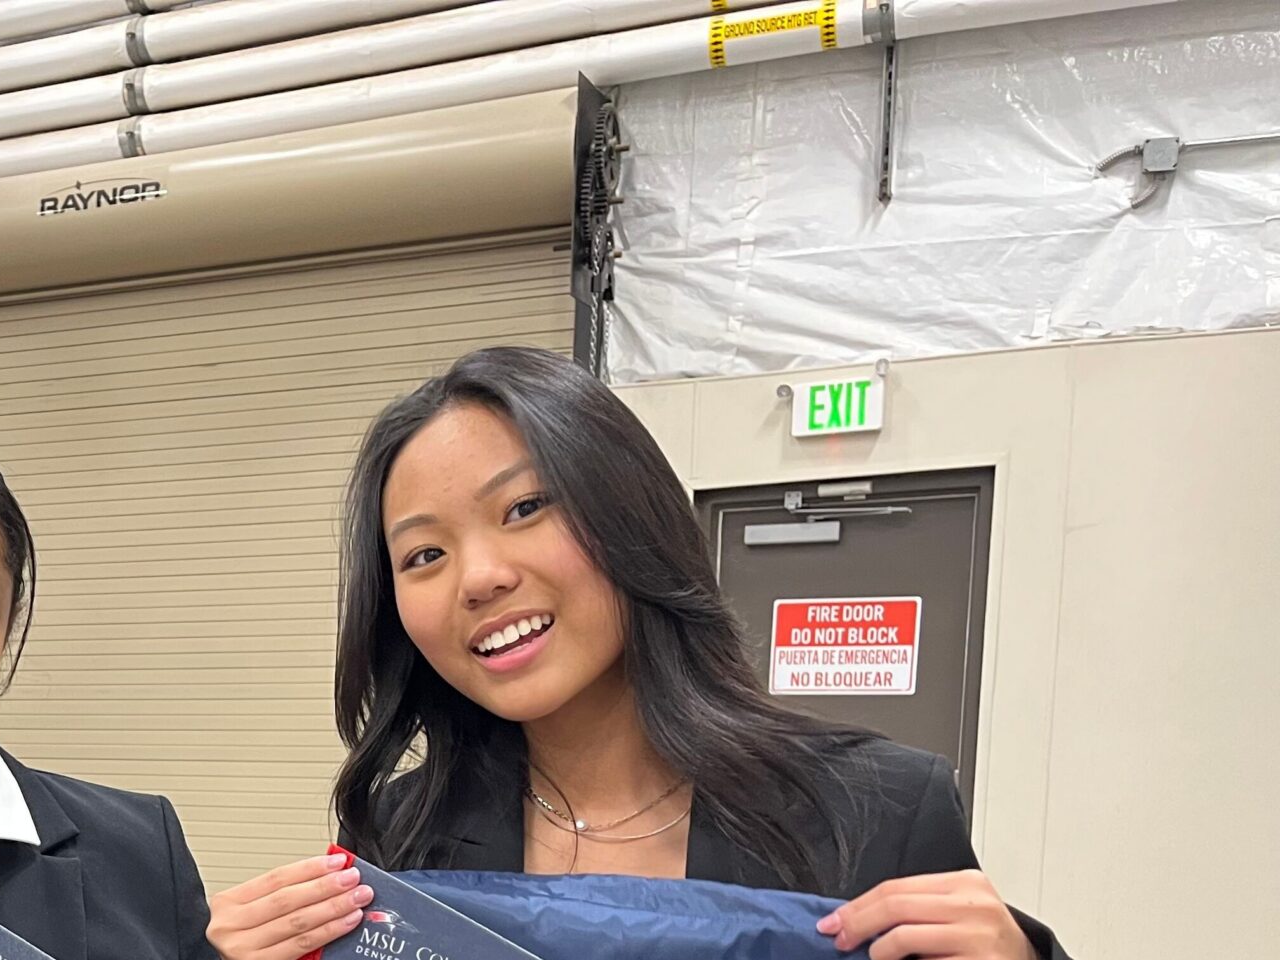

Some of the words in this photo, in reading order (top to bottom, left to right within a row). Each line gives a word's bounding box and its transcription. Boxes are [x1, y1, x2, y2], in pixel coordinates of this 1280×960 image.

[723, 21, 754, 38] GROUND
[756, 16, 785, 33] SOURCE
[787, 13, 802, 28] HTG
[804, 11, 818, 25] RET
[40, 182, 161, 216] RAYNOR
[808, 380, 871, 430] EXIT
[807, 605, 839, 623] FIRE
[842, 604, 884, 622] DOOR
[791, 628, 811, 645] DO
[814, 627, 846, 645] NOT
[847, 626, 898, 644] BLOCK
[778, 650, 819, 665] PUERTA
[822, 650, 835, 665] DE
[838, 649, 908, 665] EMERGENCIA
[790, 671, 810, 687] NO
[814, 671, 893, 688] BLOQUEAR
[360, 927, 405, 954] MSU
